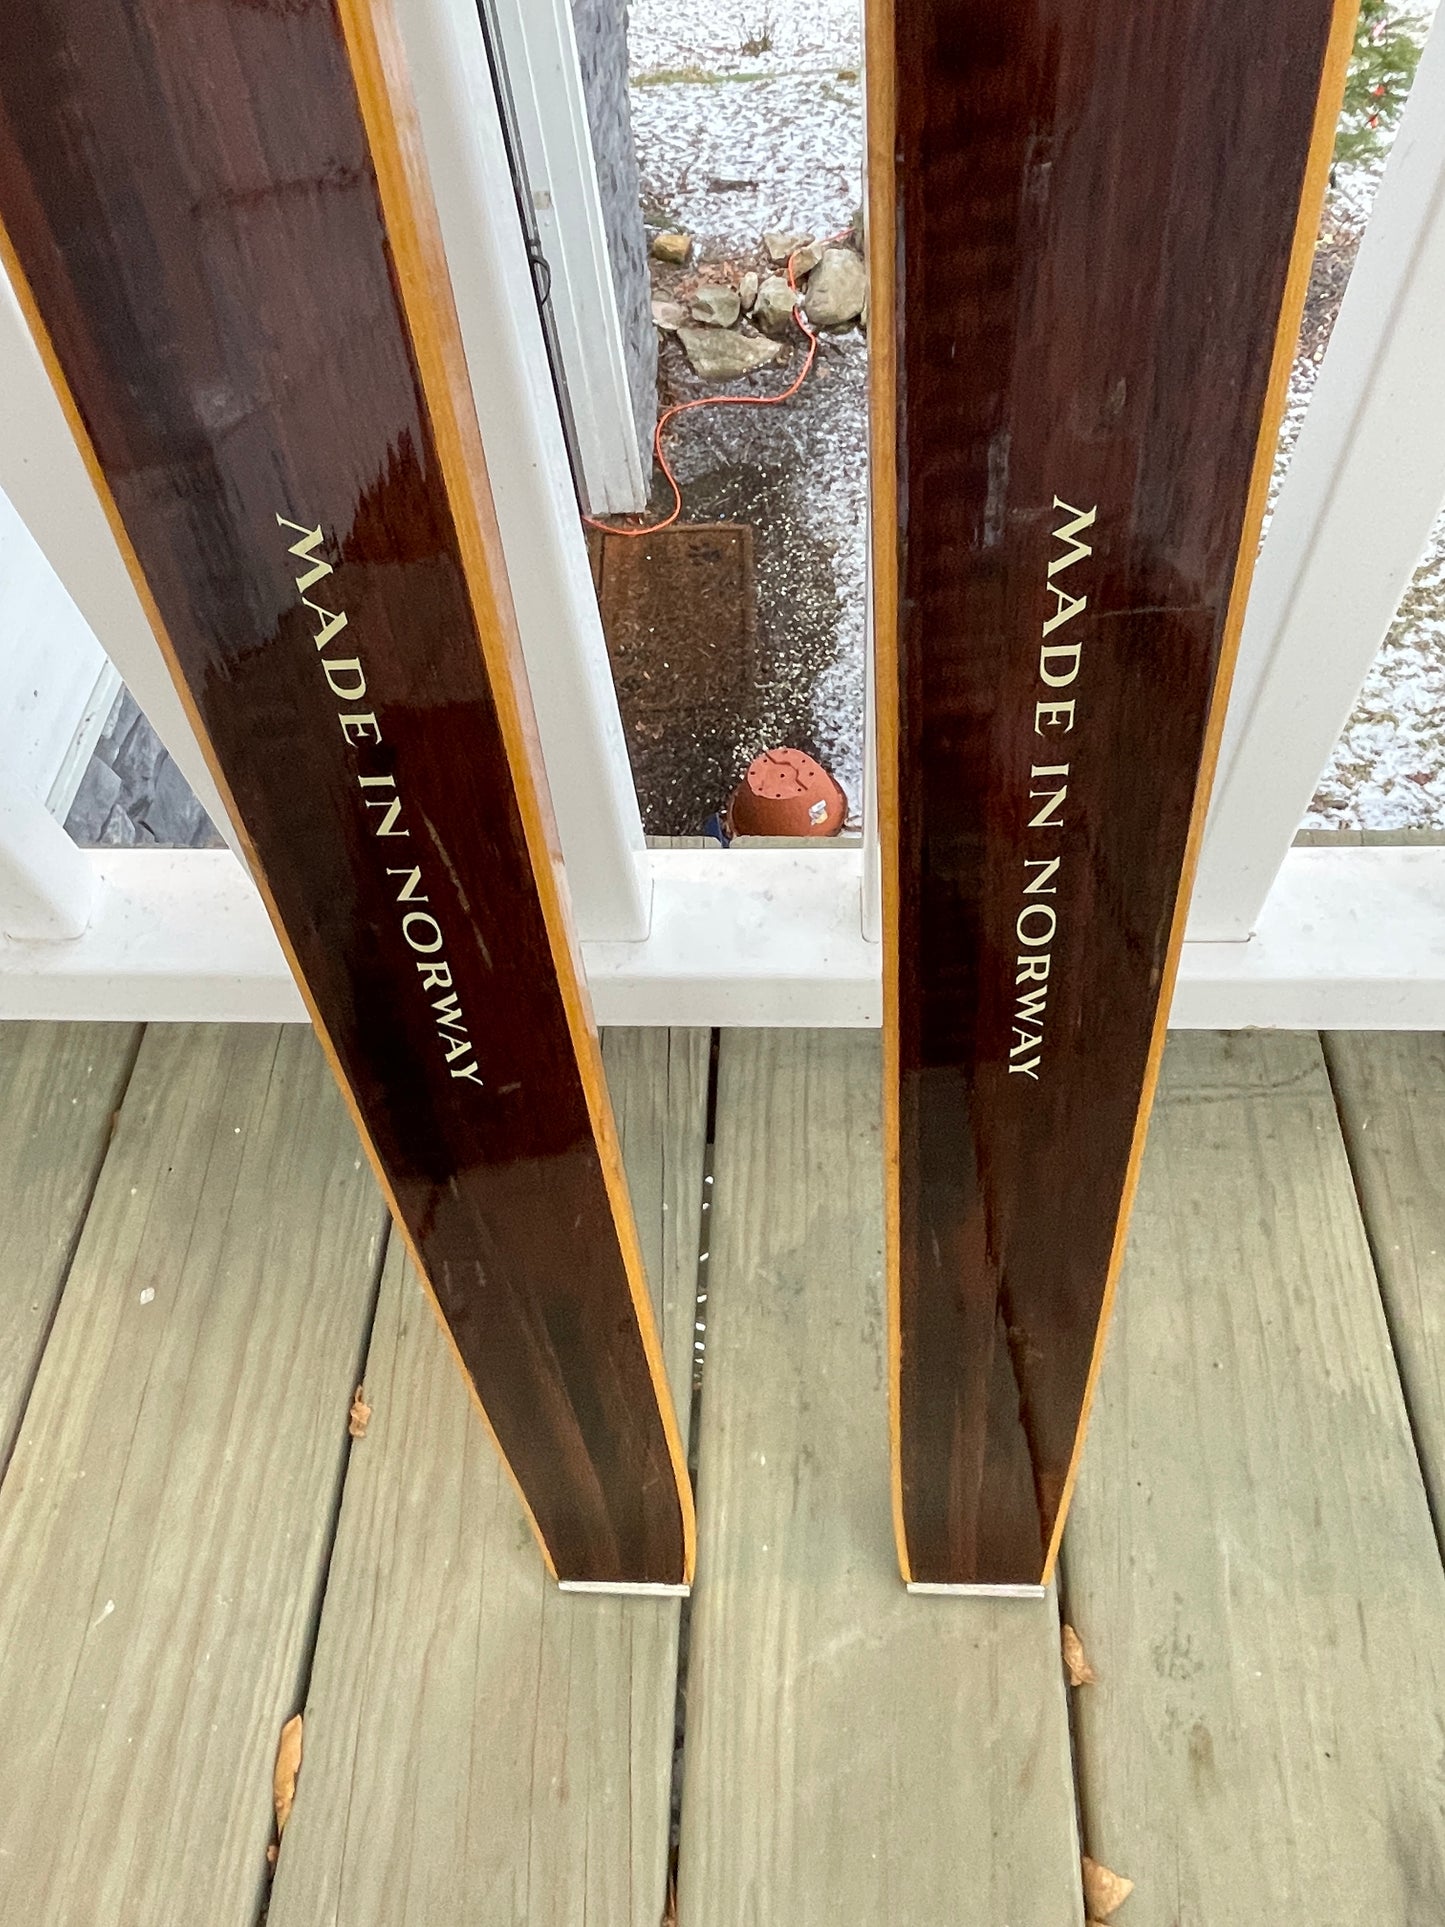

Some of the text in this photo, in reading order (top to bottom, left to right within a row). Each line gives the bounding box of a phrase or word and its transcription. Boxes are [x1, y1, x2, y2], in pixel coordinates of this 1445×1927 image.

[275, 512, 485, 1087] MADE IN NORWAY
[1008, 494, 1097, 1080] MADE IN NORWAY
